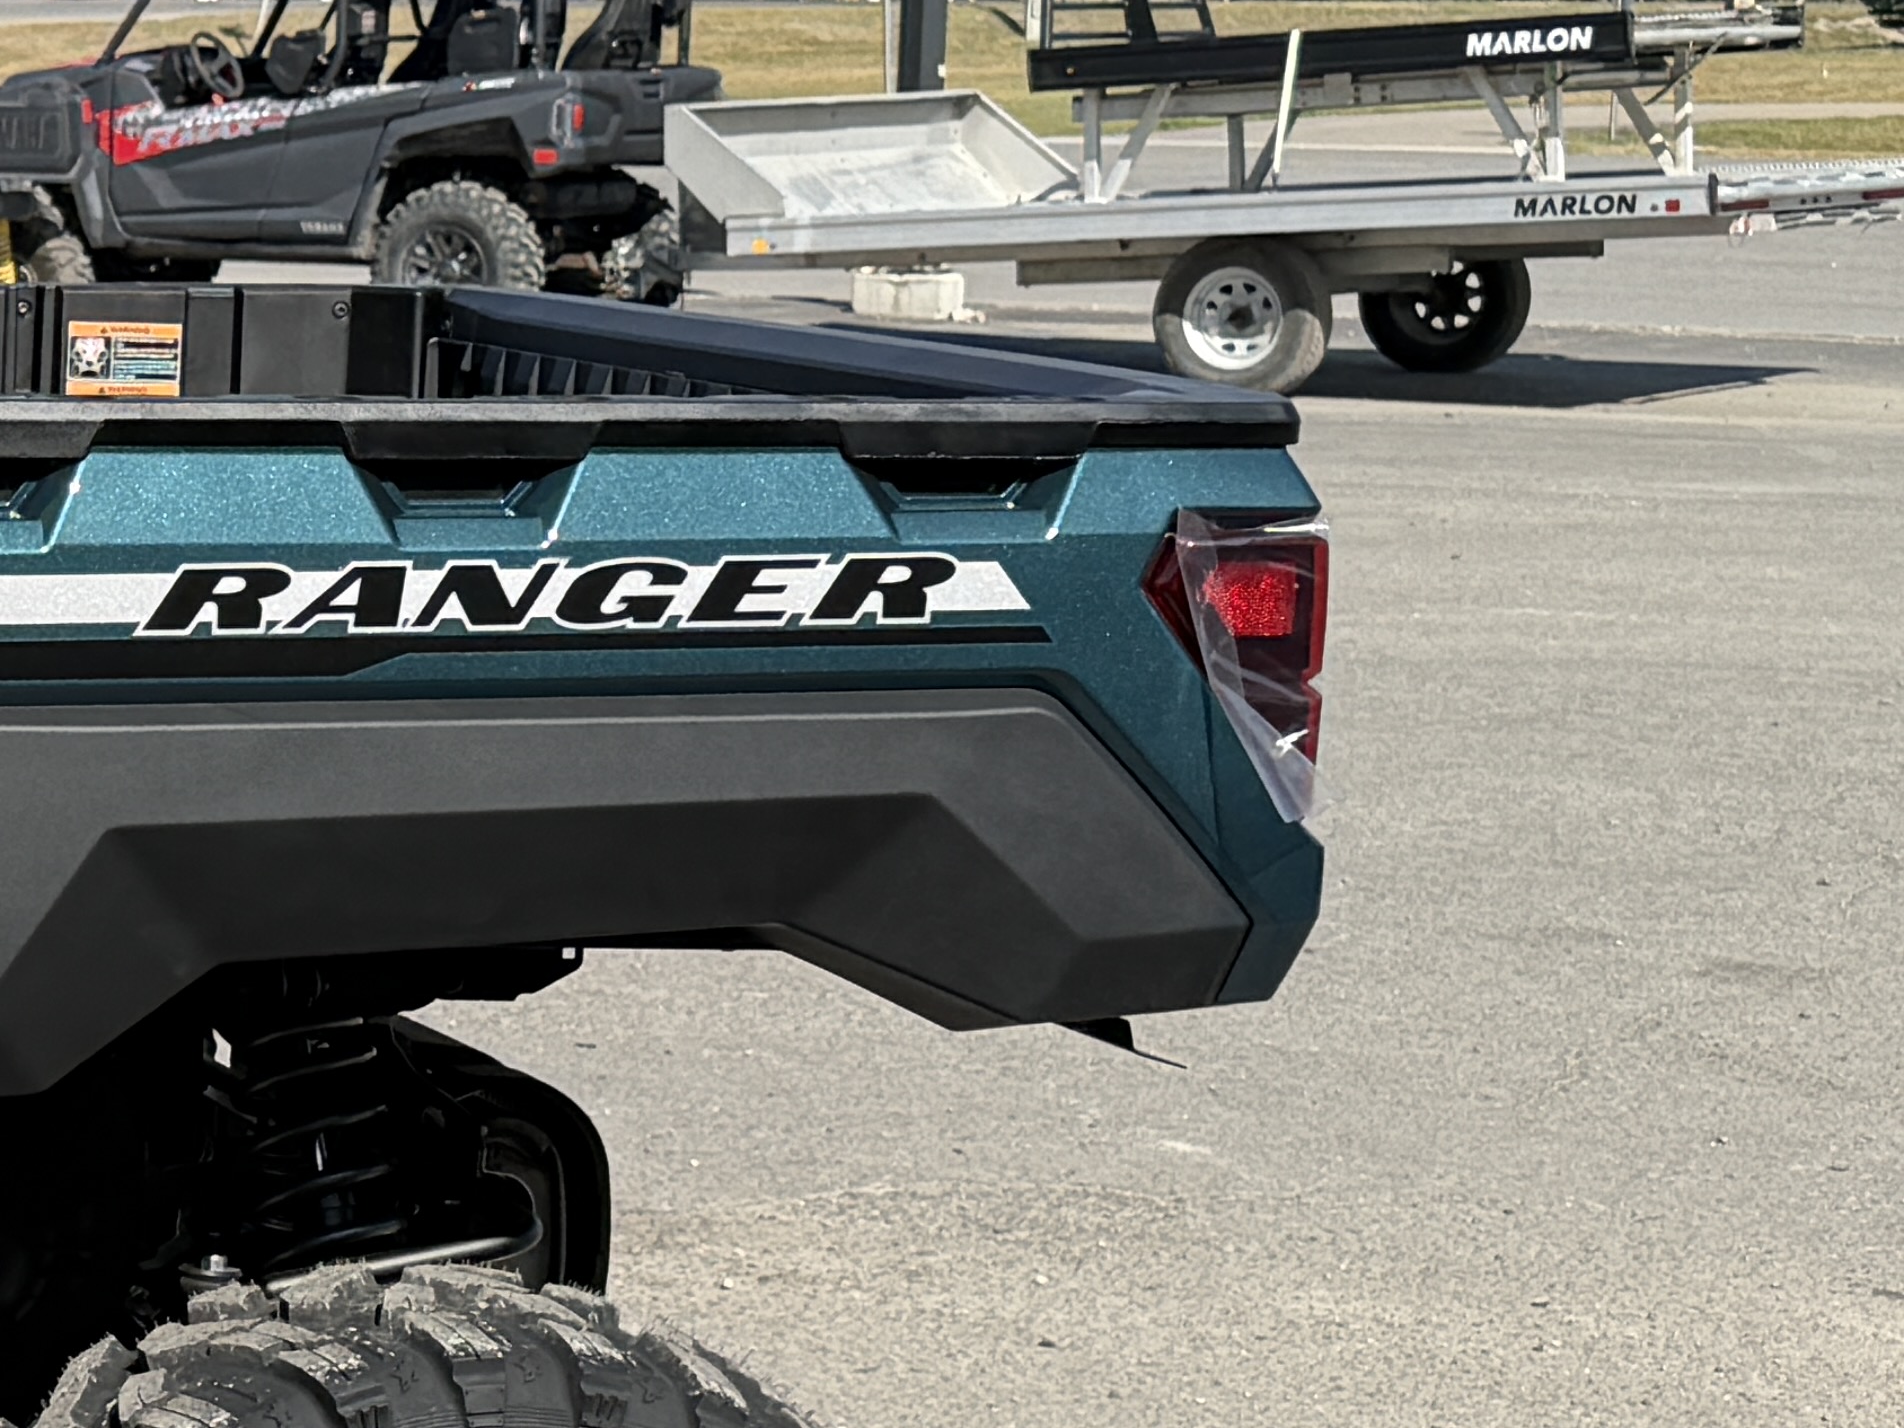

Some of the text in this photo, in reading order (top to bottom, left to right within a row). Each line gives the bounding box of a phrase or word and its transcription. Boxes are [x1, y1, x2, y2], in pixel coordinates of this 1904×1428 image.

[1466, 26, 1593, 57] MARLON
[1514, 194, 1637, 217] MARLON
[136, 553, 959, 638] RANGER
